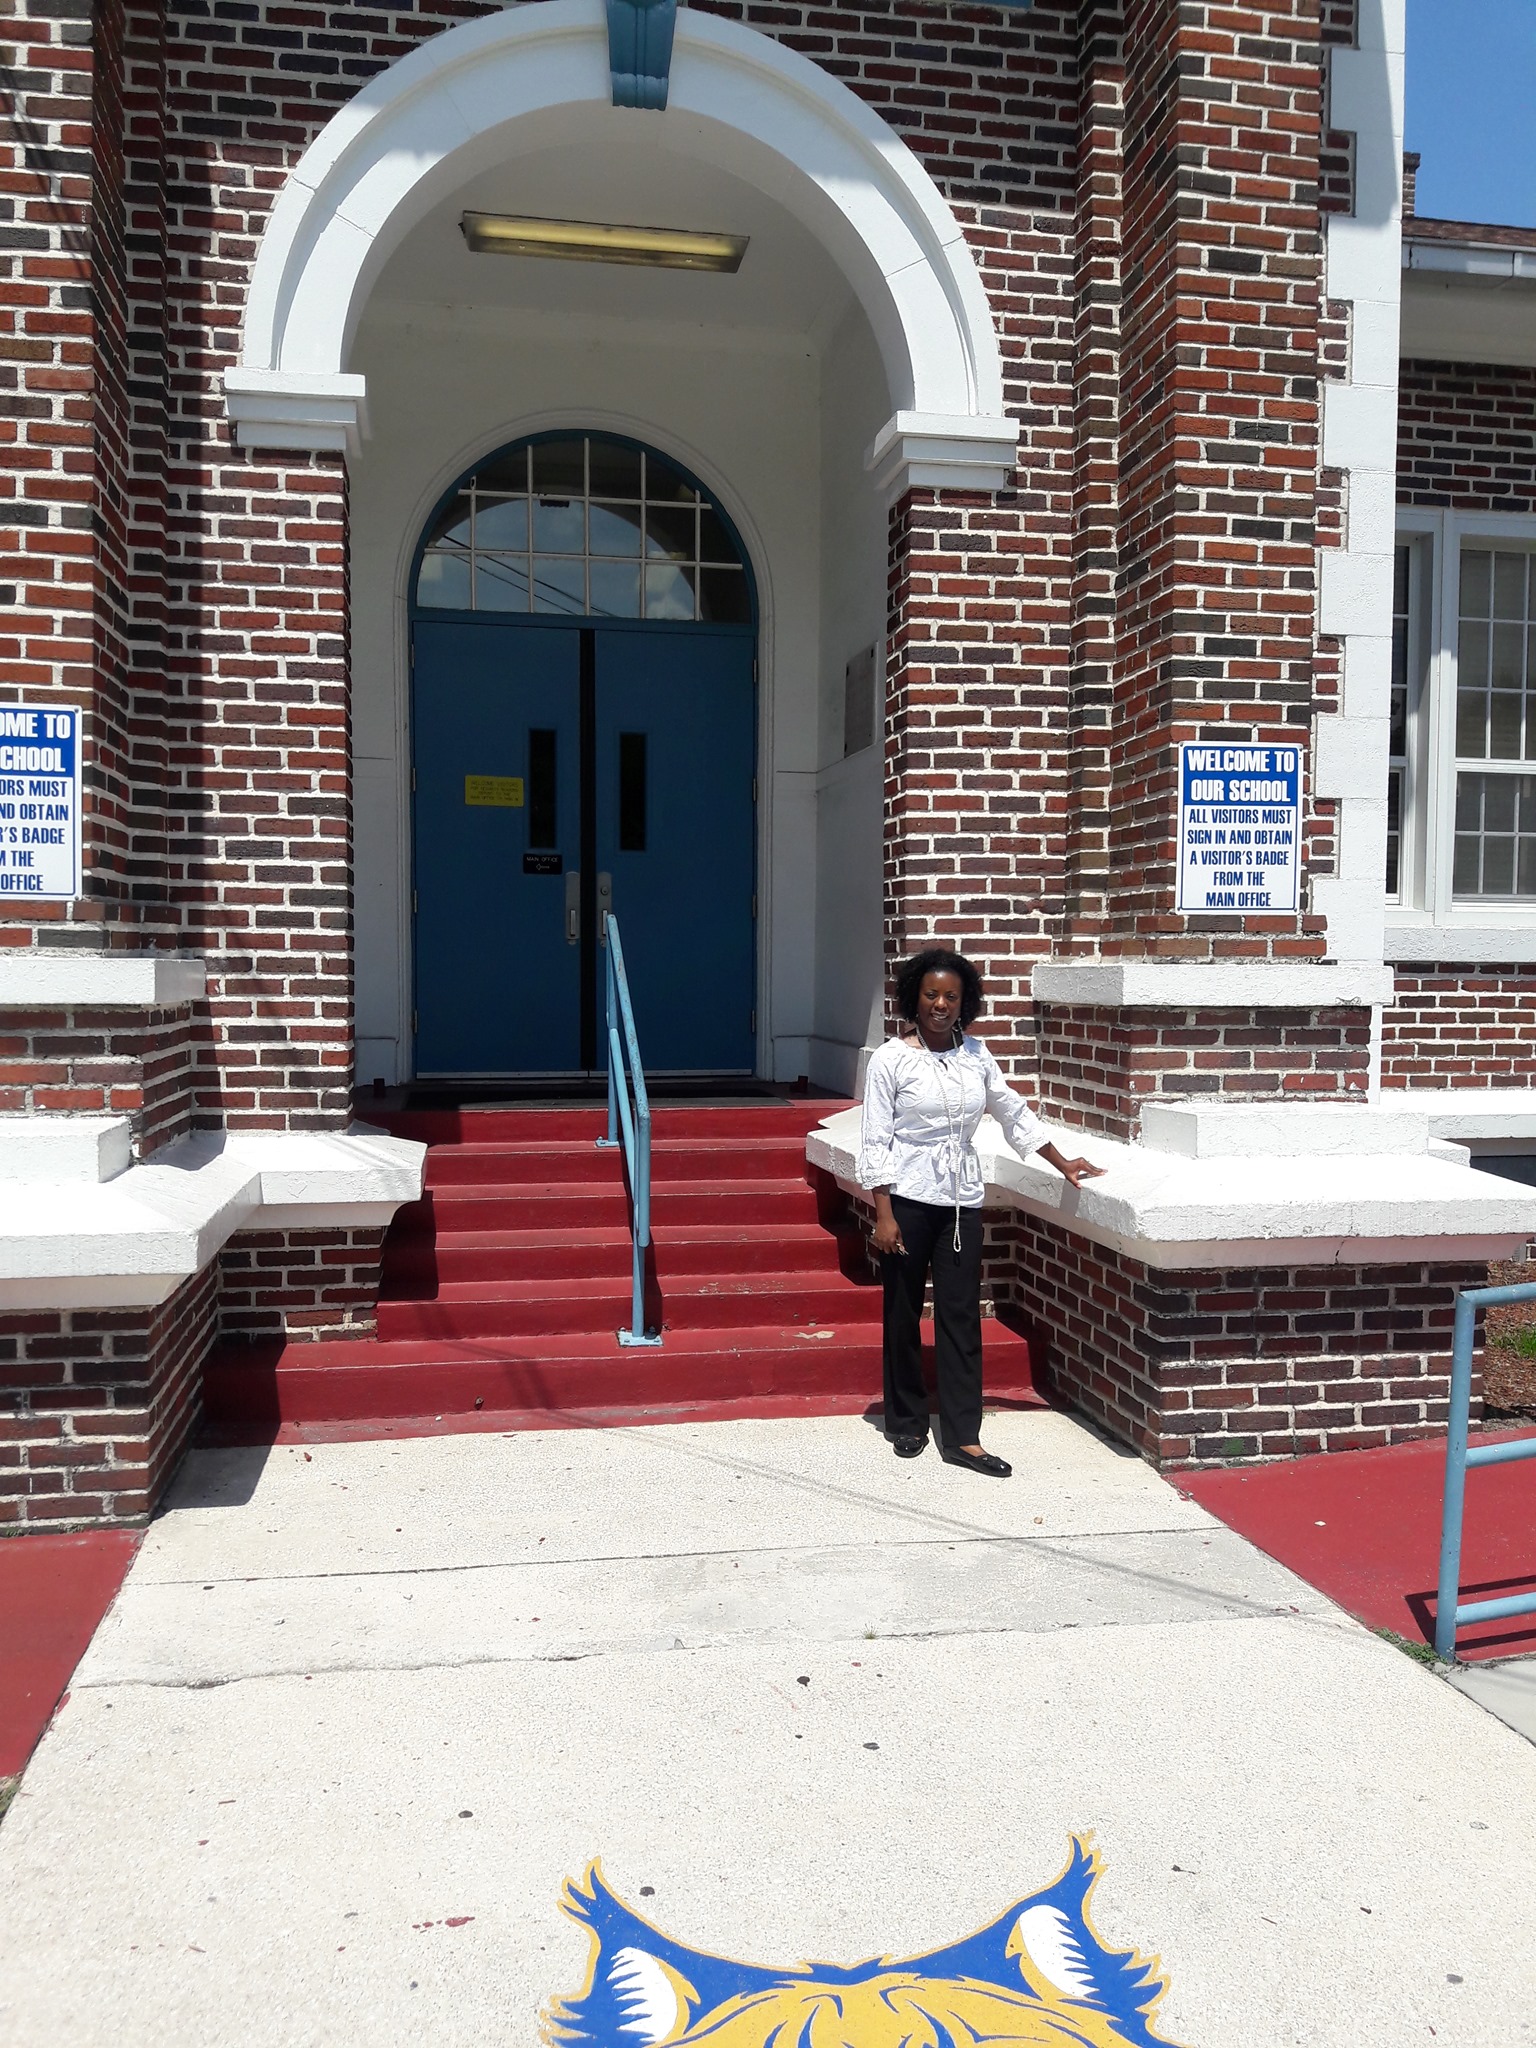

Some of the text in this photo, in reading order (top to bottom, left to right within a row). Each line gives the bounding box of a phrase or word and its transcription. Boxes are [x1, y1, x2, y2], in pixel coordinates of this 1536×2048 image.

[44, 714, 71, 739] TO
[1187, 749, 1295, 773] WELCOME TO
[29, 780, 67, 798] MUST
[1191, 779, 1291, 802] OUR SCHOOL
[19, 804, 69, 821] OBTAIN
[1188, 809, 1292, 825] ALL VISITORS MUST
[22, 827, 65, 845] BADGE
[1187, 829, 1292, 845] SIGN IN AND OBTAIN
[10, 850, 35, 867] THE
[1189, 850, 1289, 866] A VISITOR'S BADGE
[1, 873, 44, 891] OFFICE
[1213, 871, 1265, 886] FROM THE
[1206, 892, 1271, 907] MAIN OFFICE
